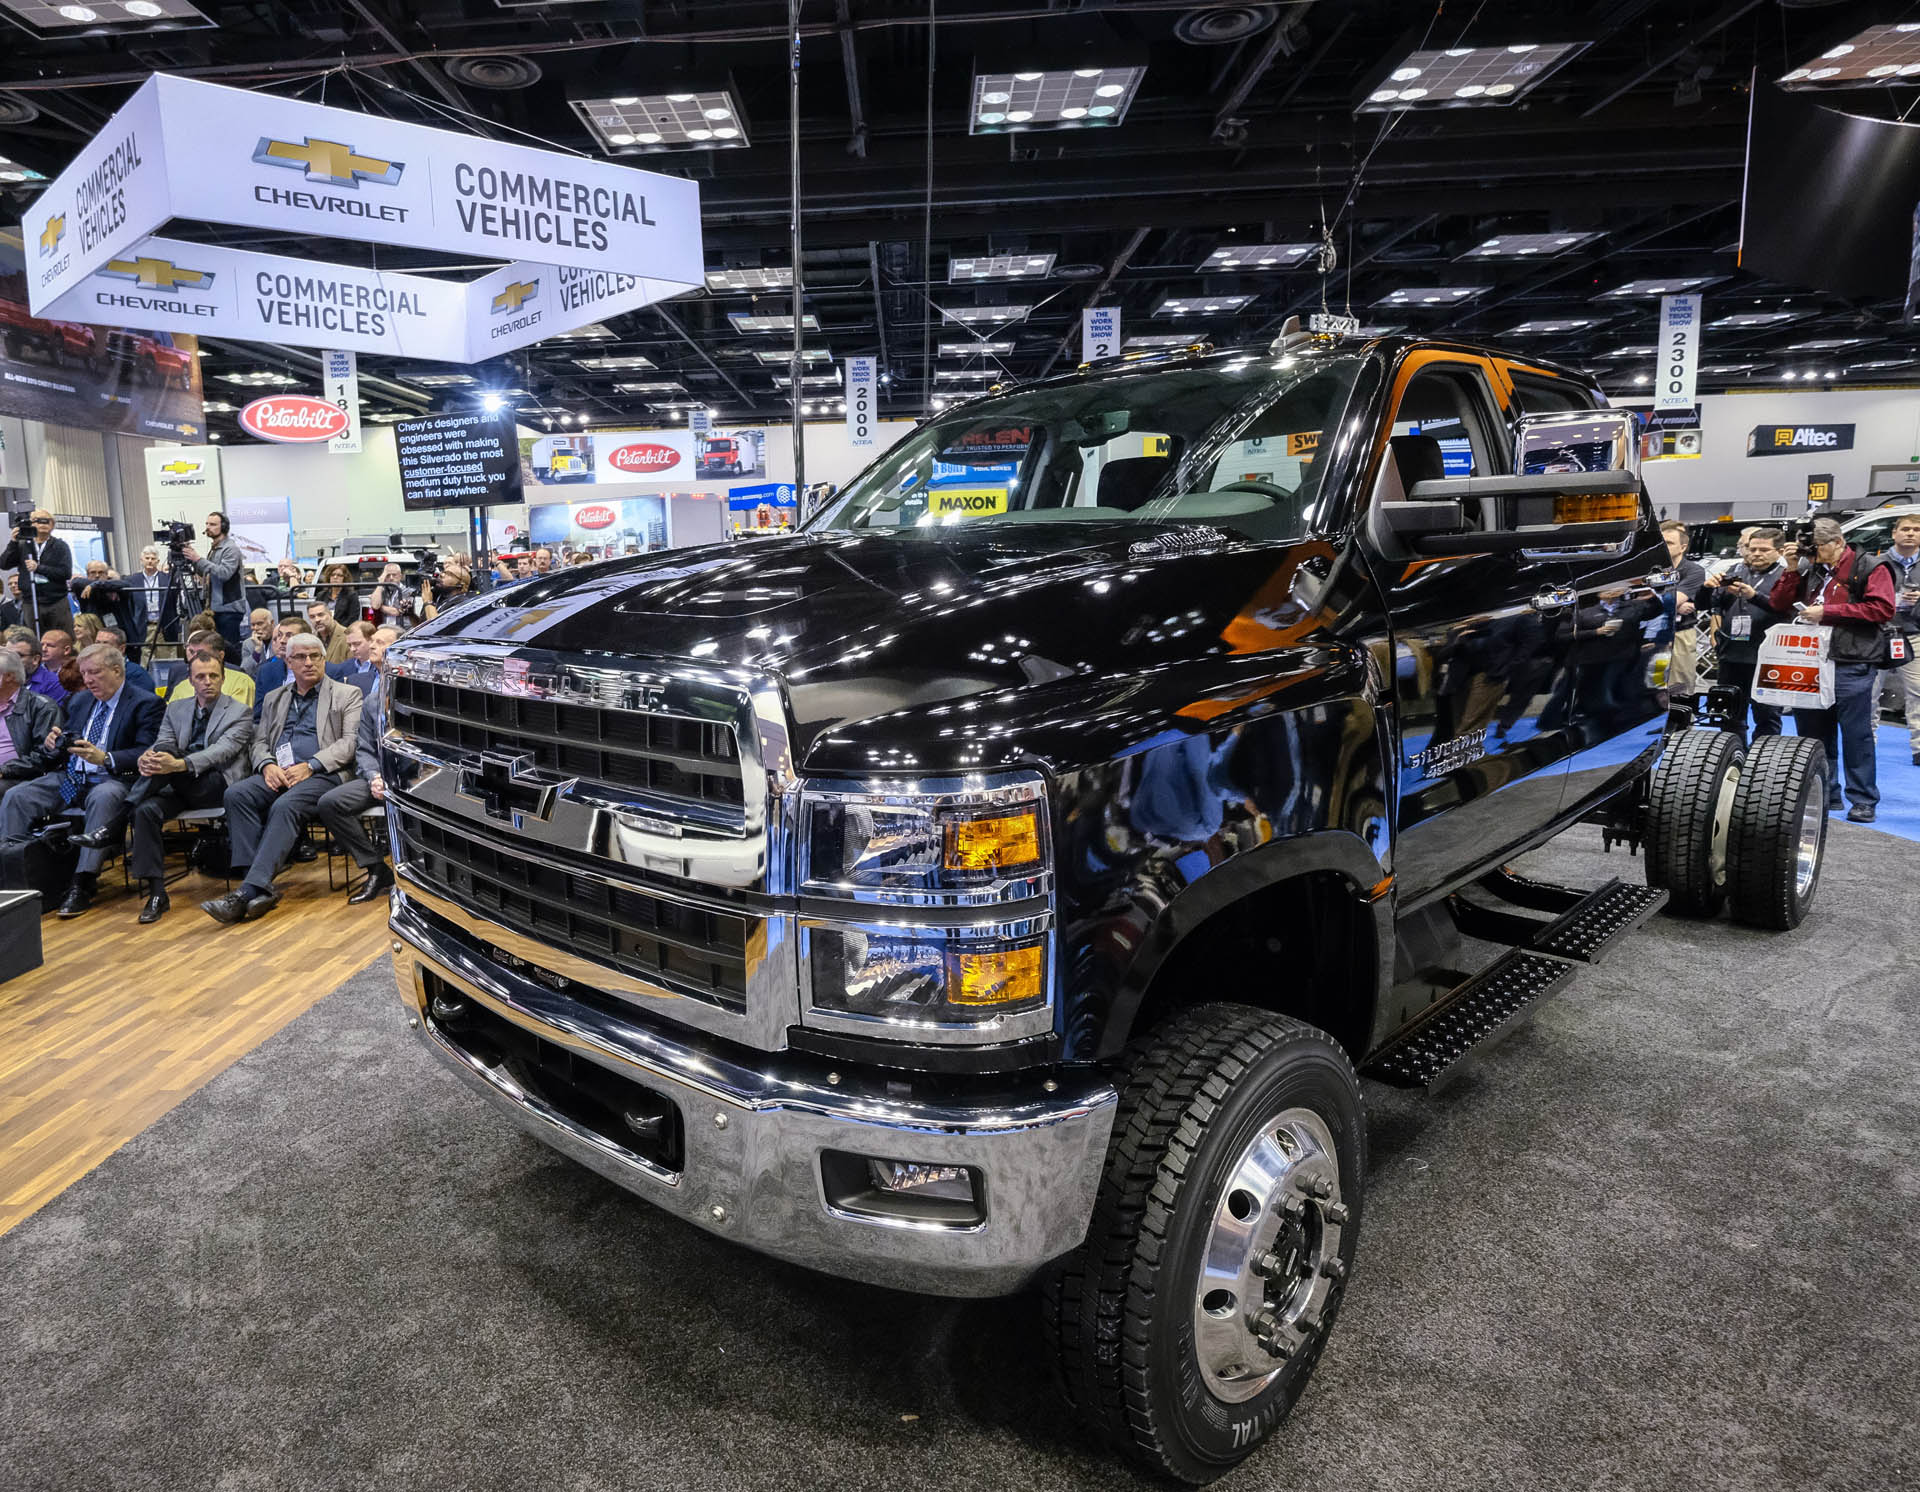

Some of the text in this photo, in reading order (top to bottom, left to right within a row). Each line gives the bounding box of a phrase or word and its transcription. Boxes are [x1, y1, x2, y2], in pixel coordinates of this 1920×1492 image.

[76, 131, 142, 219] COMMERCIAL
[254, 185, 409, 223] CHEVROLET
[455, 162, 657, 227] COMMERCIAL
[79, 188, 126, 255] VEHICLES
[455, 199, 609, 252] VEHICLES
[41, 253, 71, 288] CHEVROLET
[95, 292, 219, 317] CHEVROLET
[256, 271, 427, 317] COMMERCIAL
[559, 274, 636, 312] VEHICLES
[257, 298, 386, 337] VEHICLES
[491, 311, 542, 339] CHEVROLET
[1096, 344, 1109, 357] 2
[1669, 332, 1687, 394] 2300
[256, 404, 340, 429] Peterbilt
[398, 414, 498, 432] Chevy's designers and
[856, 387, 868, 437] 2000
[399, 429, 467, 445] engineers were
[401, 438, 499, 455] obsessed with making
[1792, 428, 1837, 446] Altec
[402, 448, 504, 466] this Silverado the most
[616, 448, 675, 467] Peterbilt
[404, 462, 484, 478] customer-focused
[405, 473, 506, 488] medium duty truck you
[407, 485, 489, 499] can find anywhere.
[939, 495, 996, 511] MAXON
[578, 509, 613, 524] Peterbilt
